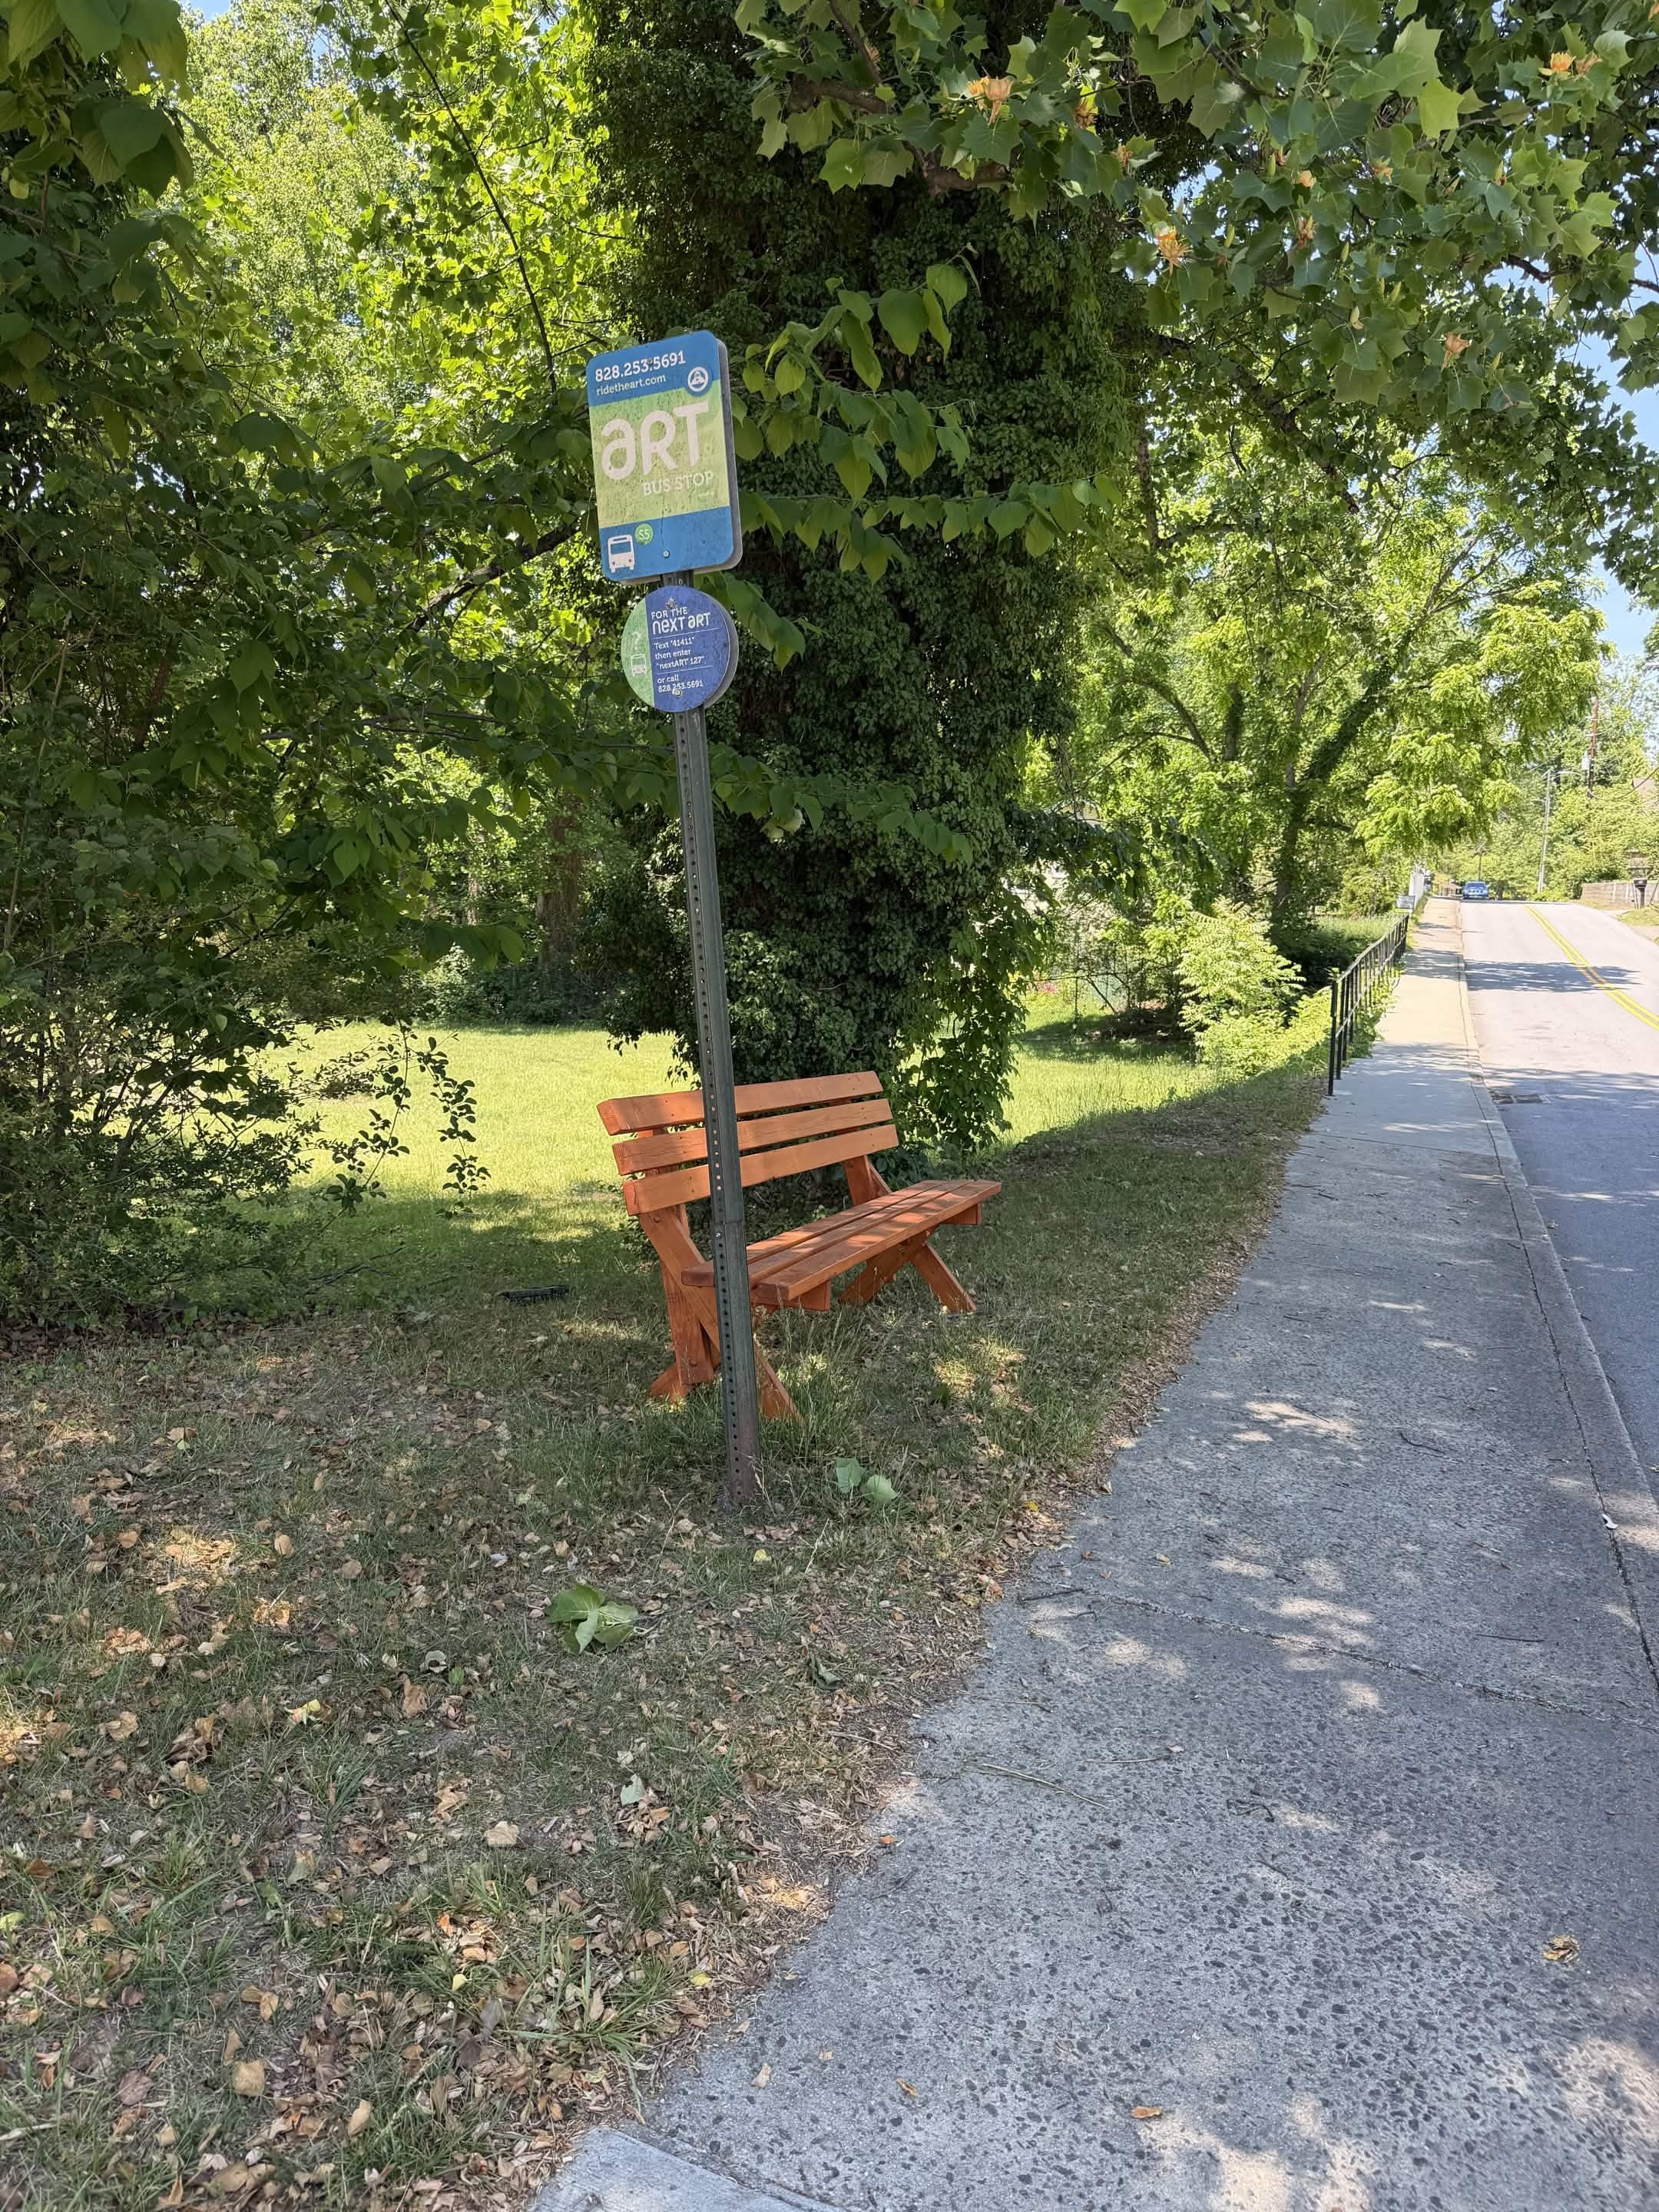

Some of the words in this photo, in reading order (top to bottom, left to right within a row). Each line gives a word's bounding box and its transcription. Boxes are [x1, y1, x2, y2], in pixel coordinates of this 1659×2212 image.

[595, 350, 686, 382] 828.253.5691
[596, 374, 667, 396] ridetheart.com
[642, 478, 671, 495] BUS
[676, 470, 714, 490] STOP
[651, 610, 668, 620] FOR
[670, 606, 688, 617] THE
[654, 641, 669, 650] Text
[666, 674, 679, 683] call
[657, 679, 704, 693] 828253.5691
